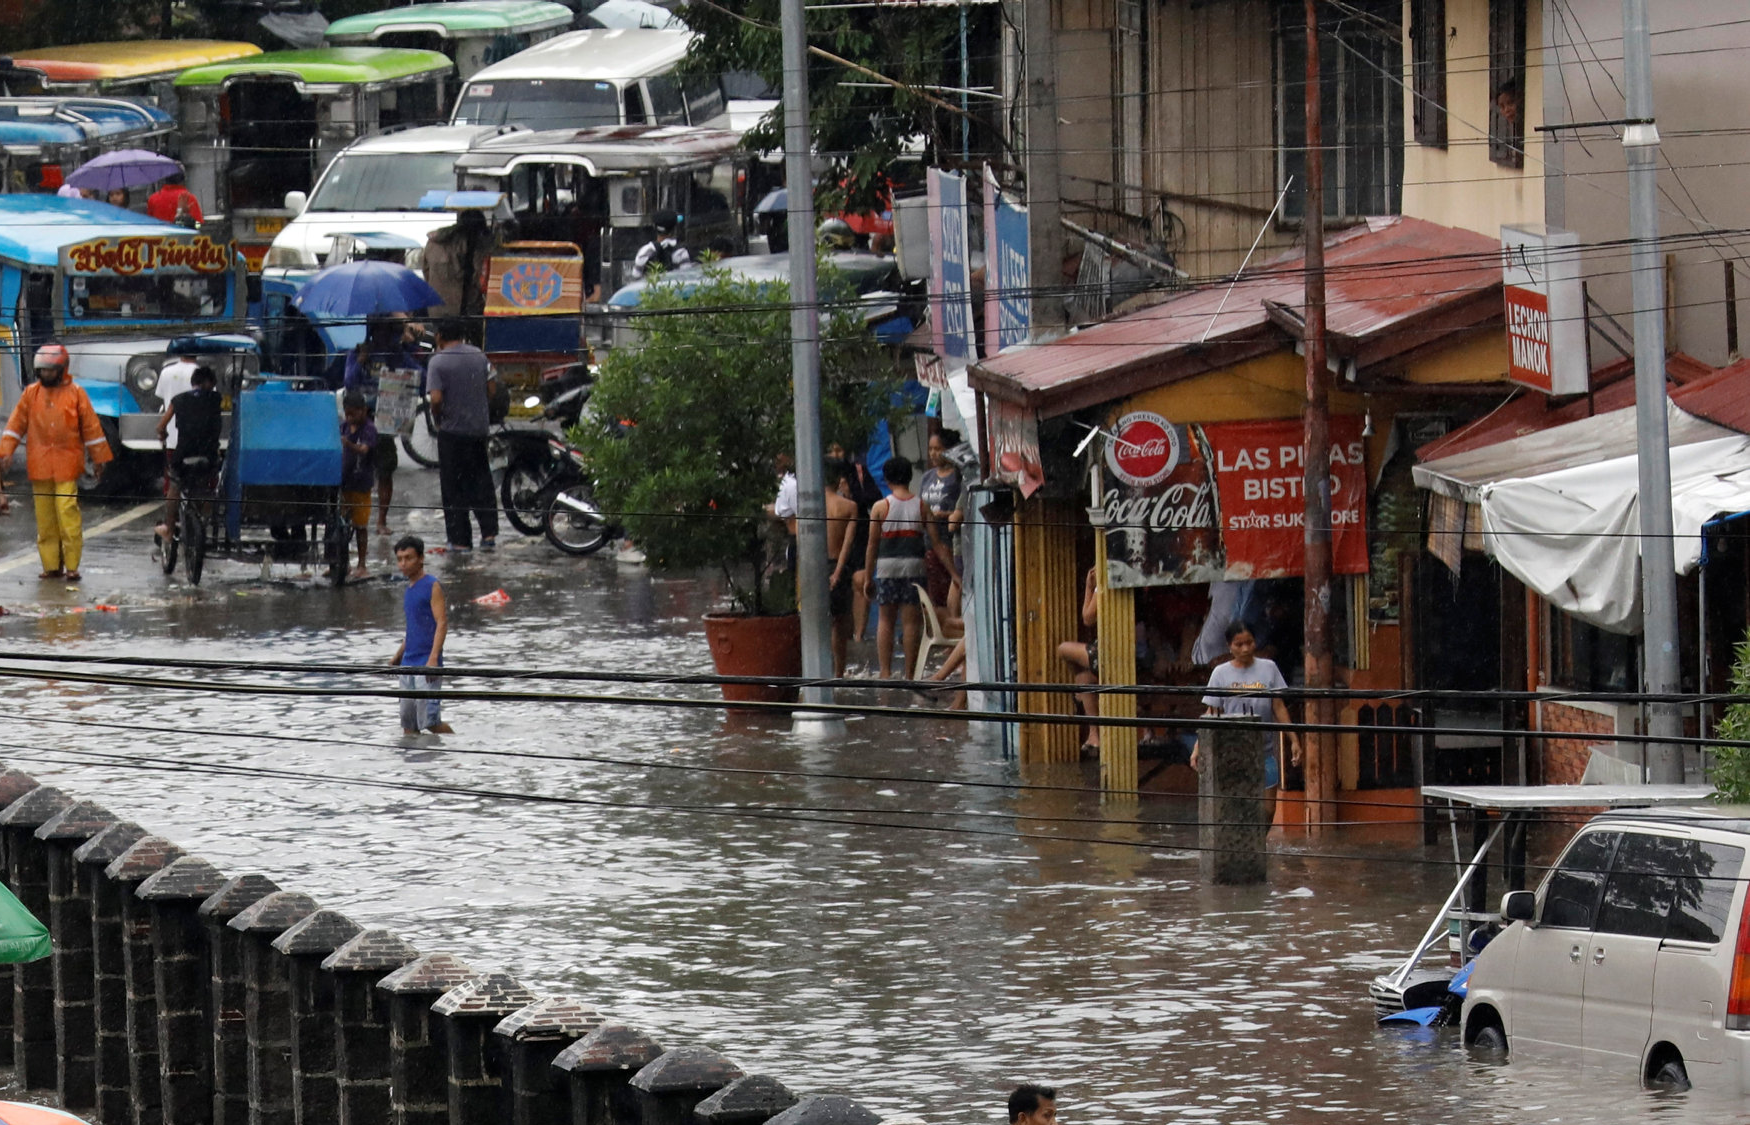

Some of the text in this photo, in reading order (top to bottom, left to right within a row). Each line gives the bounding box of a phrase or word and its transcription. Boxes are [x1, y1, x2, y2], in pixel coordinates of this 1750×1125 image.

[69, 237, 143, 275] Holy
[134, 236, 227, 273] Trinity
[1508, 302, 1548, 343] LECHON
[1512, 336, 1549, 376] MANOK
[1217, 442, 1365, 472] LAS PIAS
[1243, 474, 1342, 500] BISTO
[1273, 511, 1305, 528] SUK
